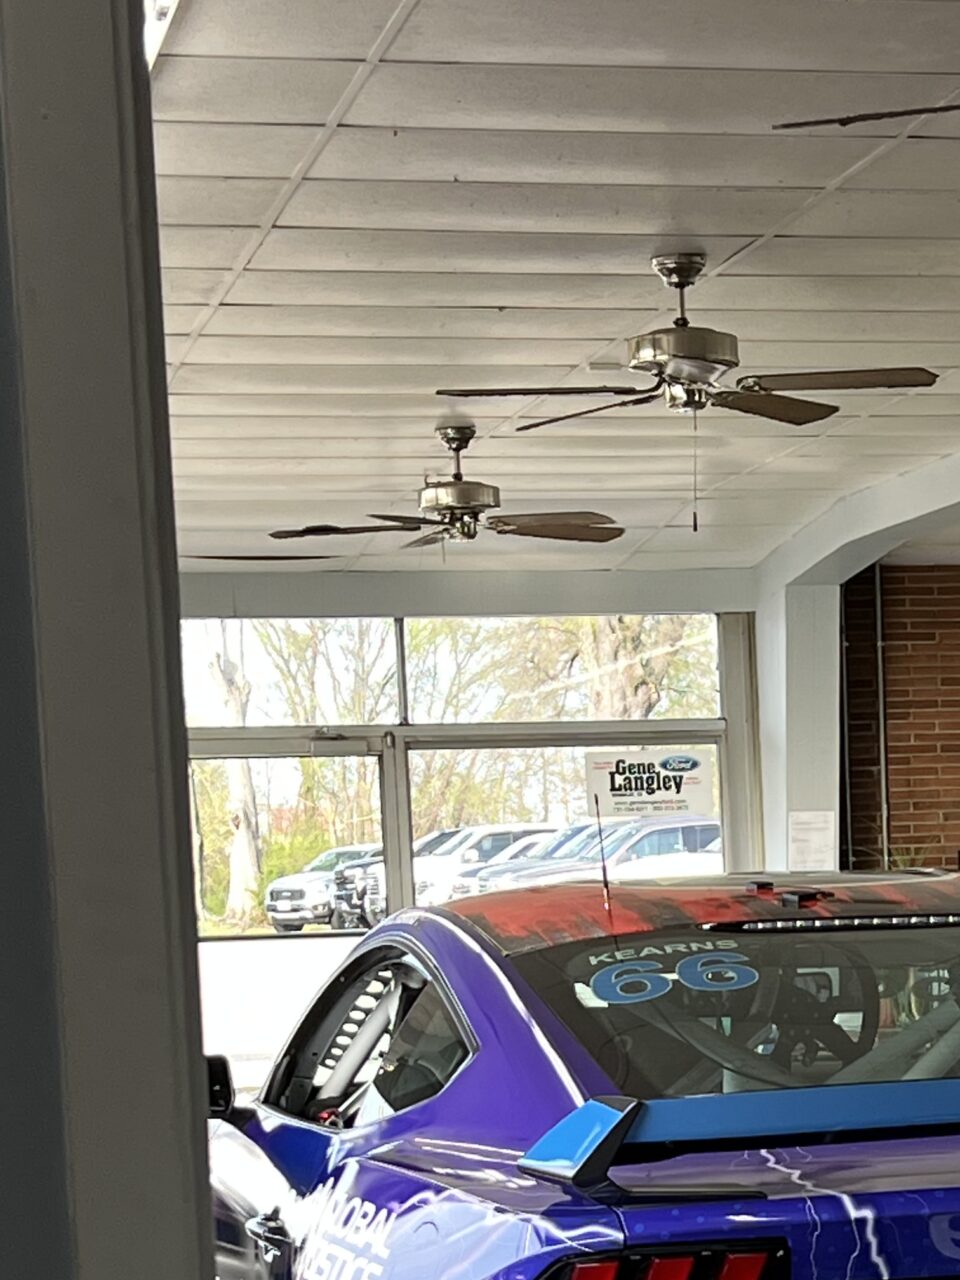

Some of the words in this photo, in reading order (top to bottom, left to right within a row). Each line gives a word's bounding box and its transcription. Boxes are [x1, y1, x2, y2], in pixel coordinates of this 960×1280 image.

[615, 759, 655, 775] Gene
[666, 759, 693, 770] Ford
[609, 771, 683, 795] Langley
[589, 940, 738, 965] KEARNS
[589, 952, 759, 1004] 66
